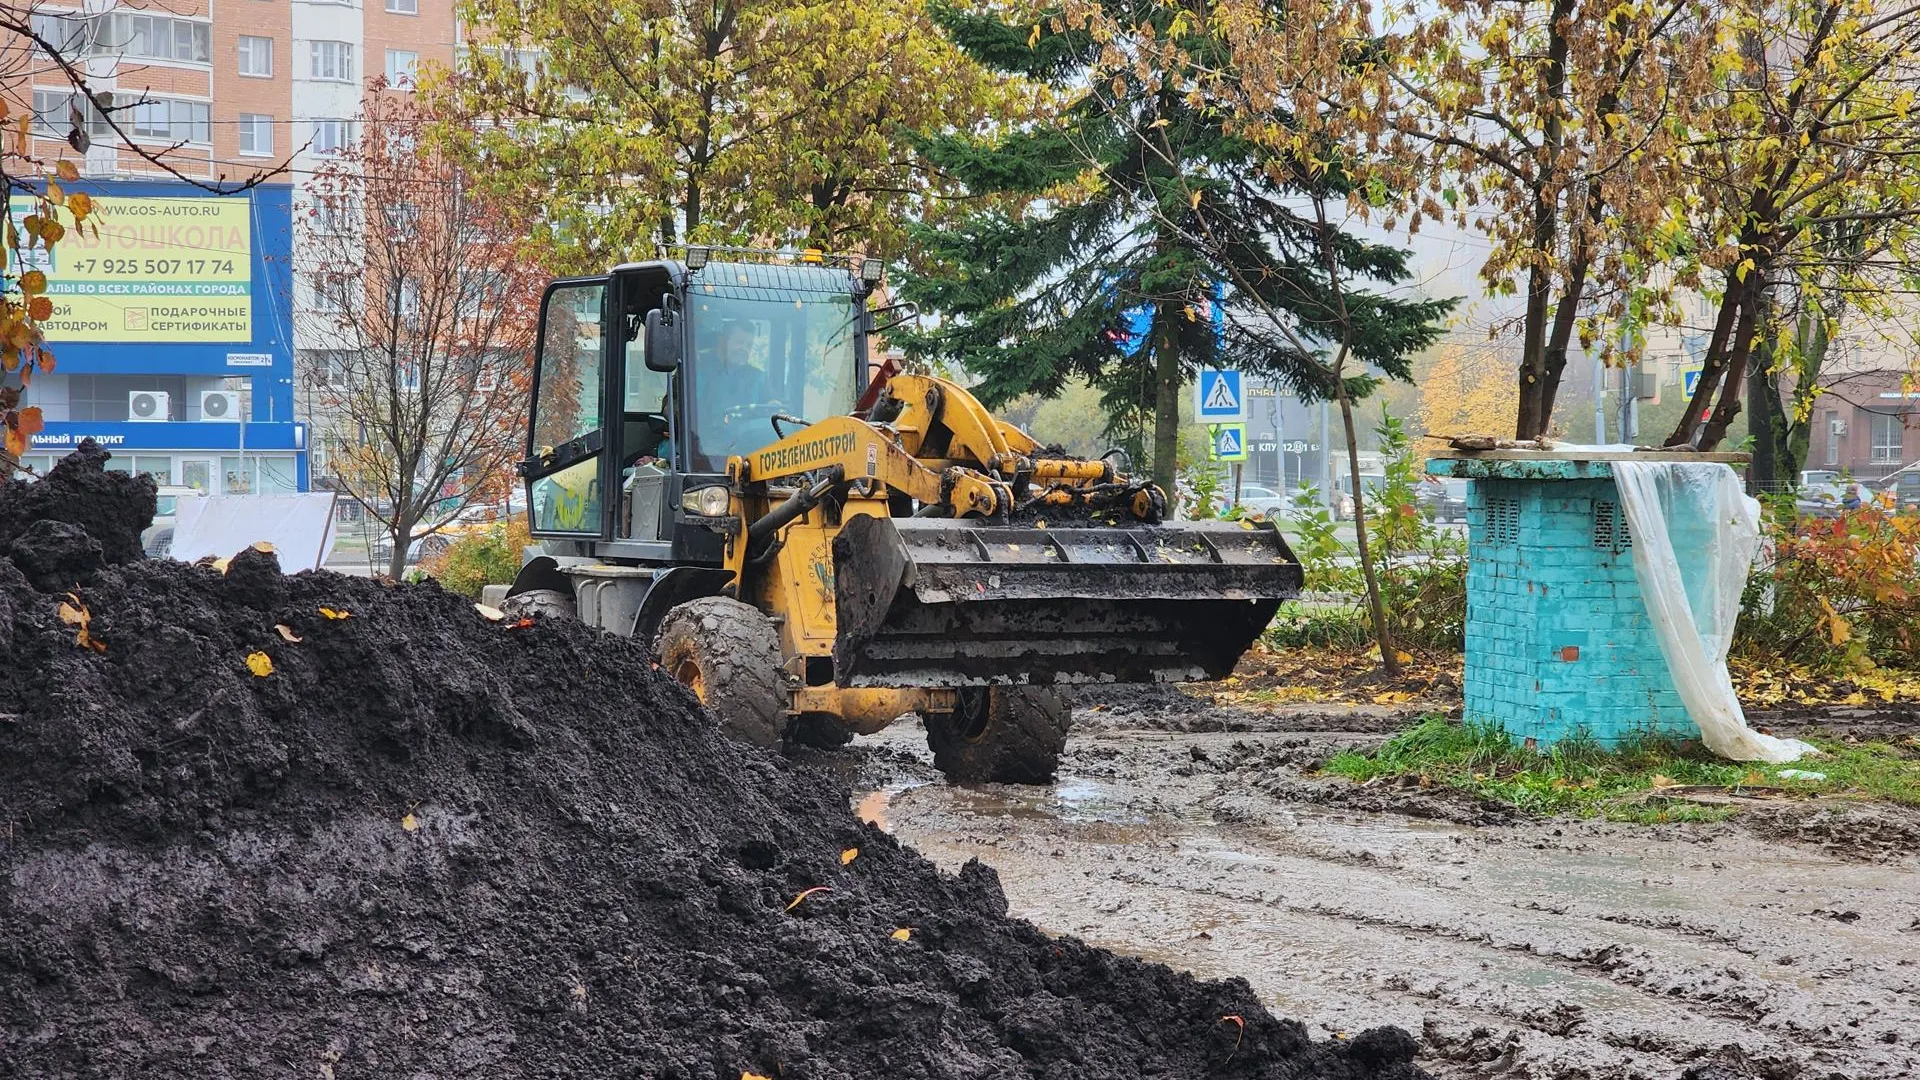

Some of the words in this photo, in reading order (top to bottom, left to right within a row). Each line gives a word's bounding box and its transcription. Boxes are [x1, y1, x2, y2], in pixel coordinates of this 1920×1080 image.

[62, 224, 246, 250] АВТОШКОЛА
[74, 259, 96, 274] +7
[103, 259, 138, 274] 925
[144, 259, 181, 274] 507
[186, 259, 206, 274] 17
[211, 259, 234, 274] 74
[78, 284, 96, 293] ВО
[99, 284, 129, 294] ВСЕХ
[132, 282, 192, 294] РАЙОНАХ
[195, 285, 246, 296] ГОРОДА
[151, 307, 247, 318] ПОДАРОЧНЫЕ
[39, 321, 108, 332] АВТОДРОМ
[151, 322, 247, 332] СЕРТИФИКАТЫ
[74, 435, 125, 446] ПДУКТ
[760, 430, 857, 475] ГОРЗЕЛЕНХОЗСТРОЙ
